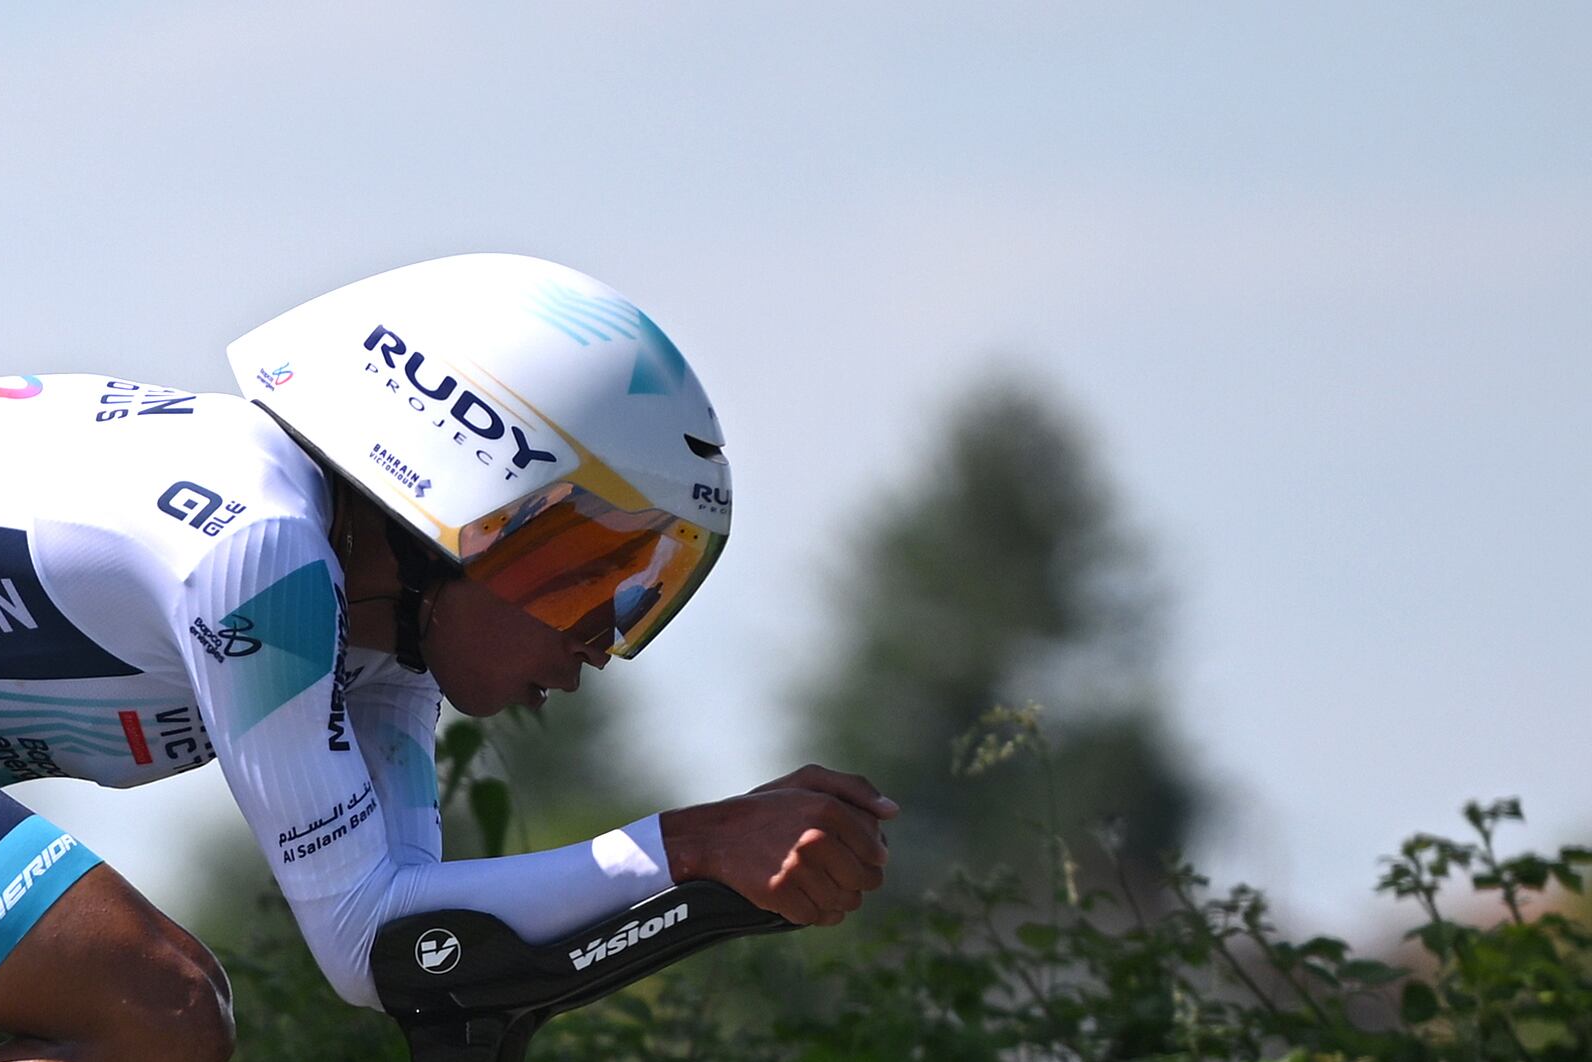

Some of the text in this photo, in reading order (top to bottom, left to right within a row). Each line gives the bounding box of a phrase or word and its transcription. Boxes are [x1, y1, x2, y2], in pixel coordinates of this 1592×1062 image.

[363, 324, 557, 470] RUDY
[365, 362, 518, 481] PROJECT
[369, 452, 414, 489] VICTORIOUS
[373, 443, 420, 483] BAHRAIN
[692, 482, 732, 506] RU
[194, 616, 223, 649] Bapco
[297, 825, 348, 859] Salam
[568, 902, 689, 972] Vision
